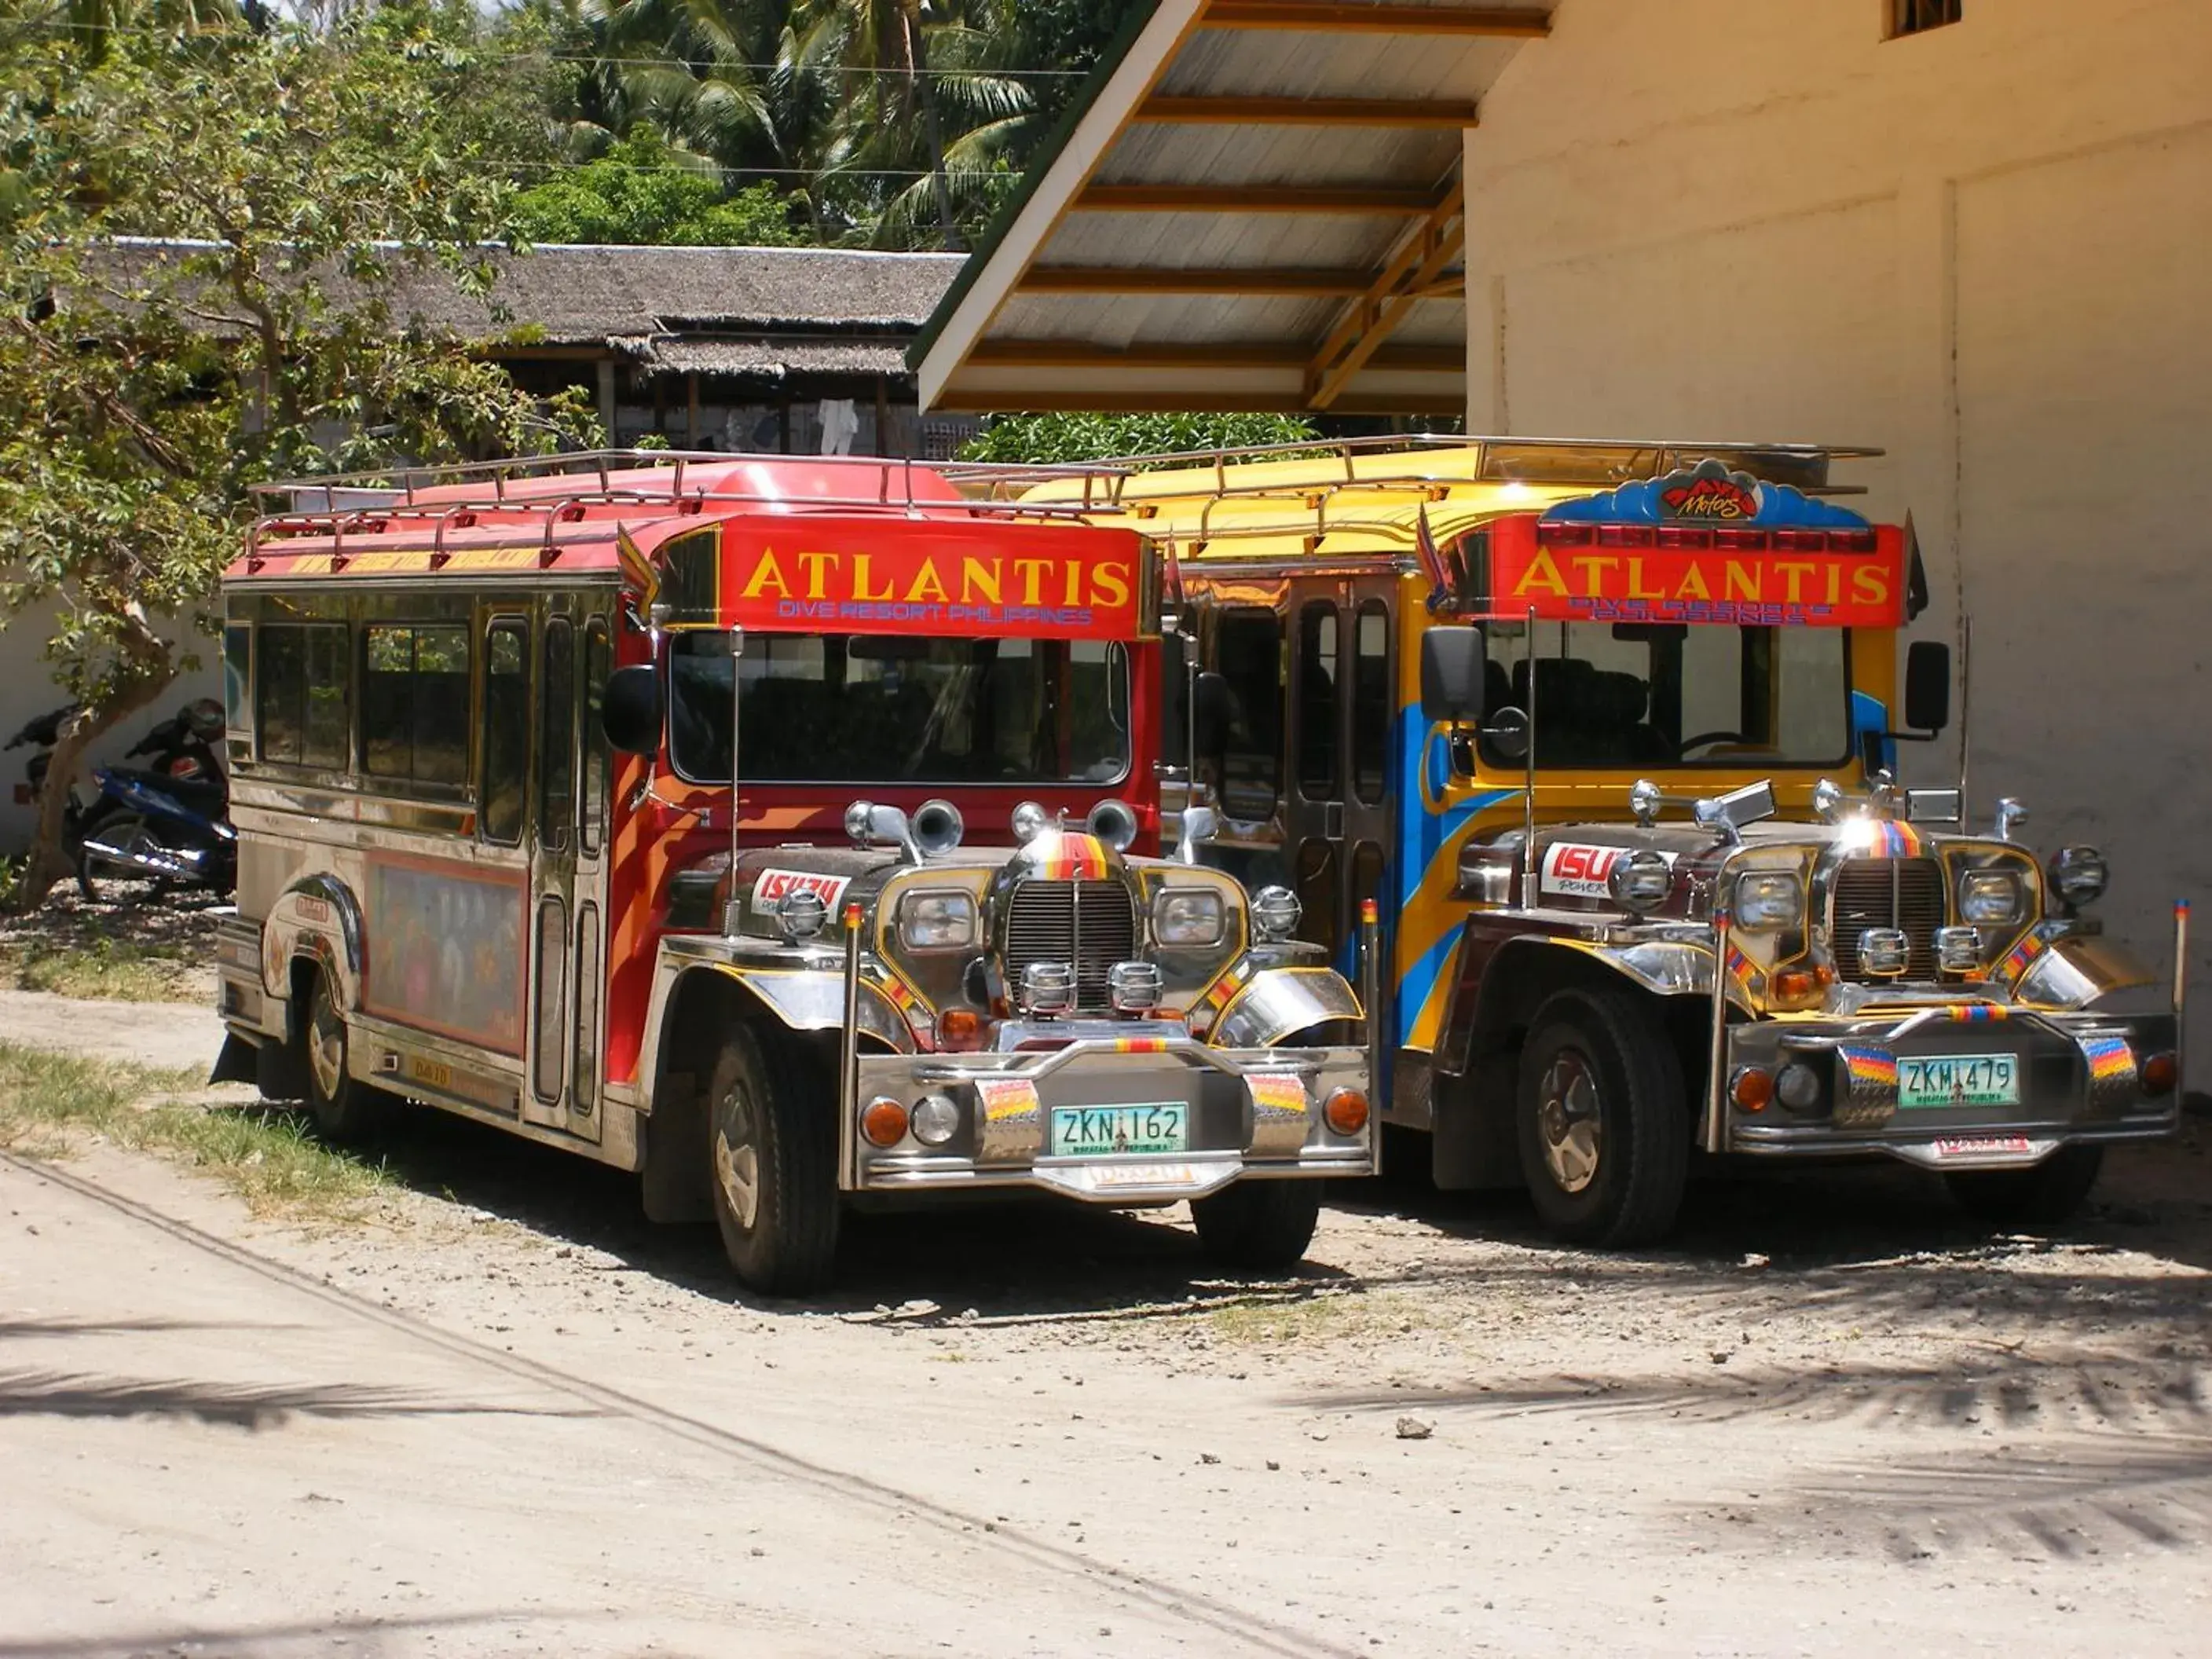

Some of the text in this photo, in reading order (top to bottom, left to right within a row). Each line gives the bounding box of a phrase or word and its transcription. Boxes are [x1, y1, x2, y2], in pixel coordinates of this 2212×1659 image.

[1675, 494, 1741, 519] Motors
[740, 545, 1130, 608] ATLANTIS
[1512, 544, 1891, 606] ATLANTIS
[778, 600, 1093, 626] DIVE RESORT PHILIPPINES
[1552, 847, 1615, 882] ISU
[1908, 1059, 2009, 1092] ZKM 479
[1063, 1109, 1178, 1144] ZKN 162
